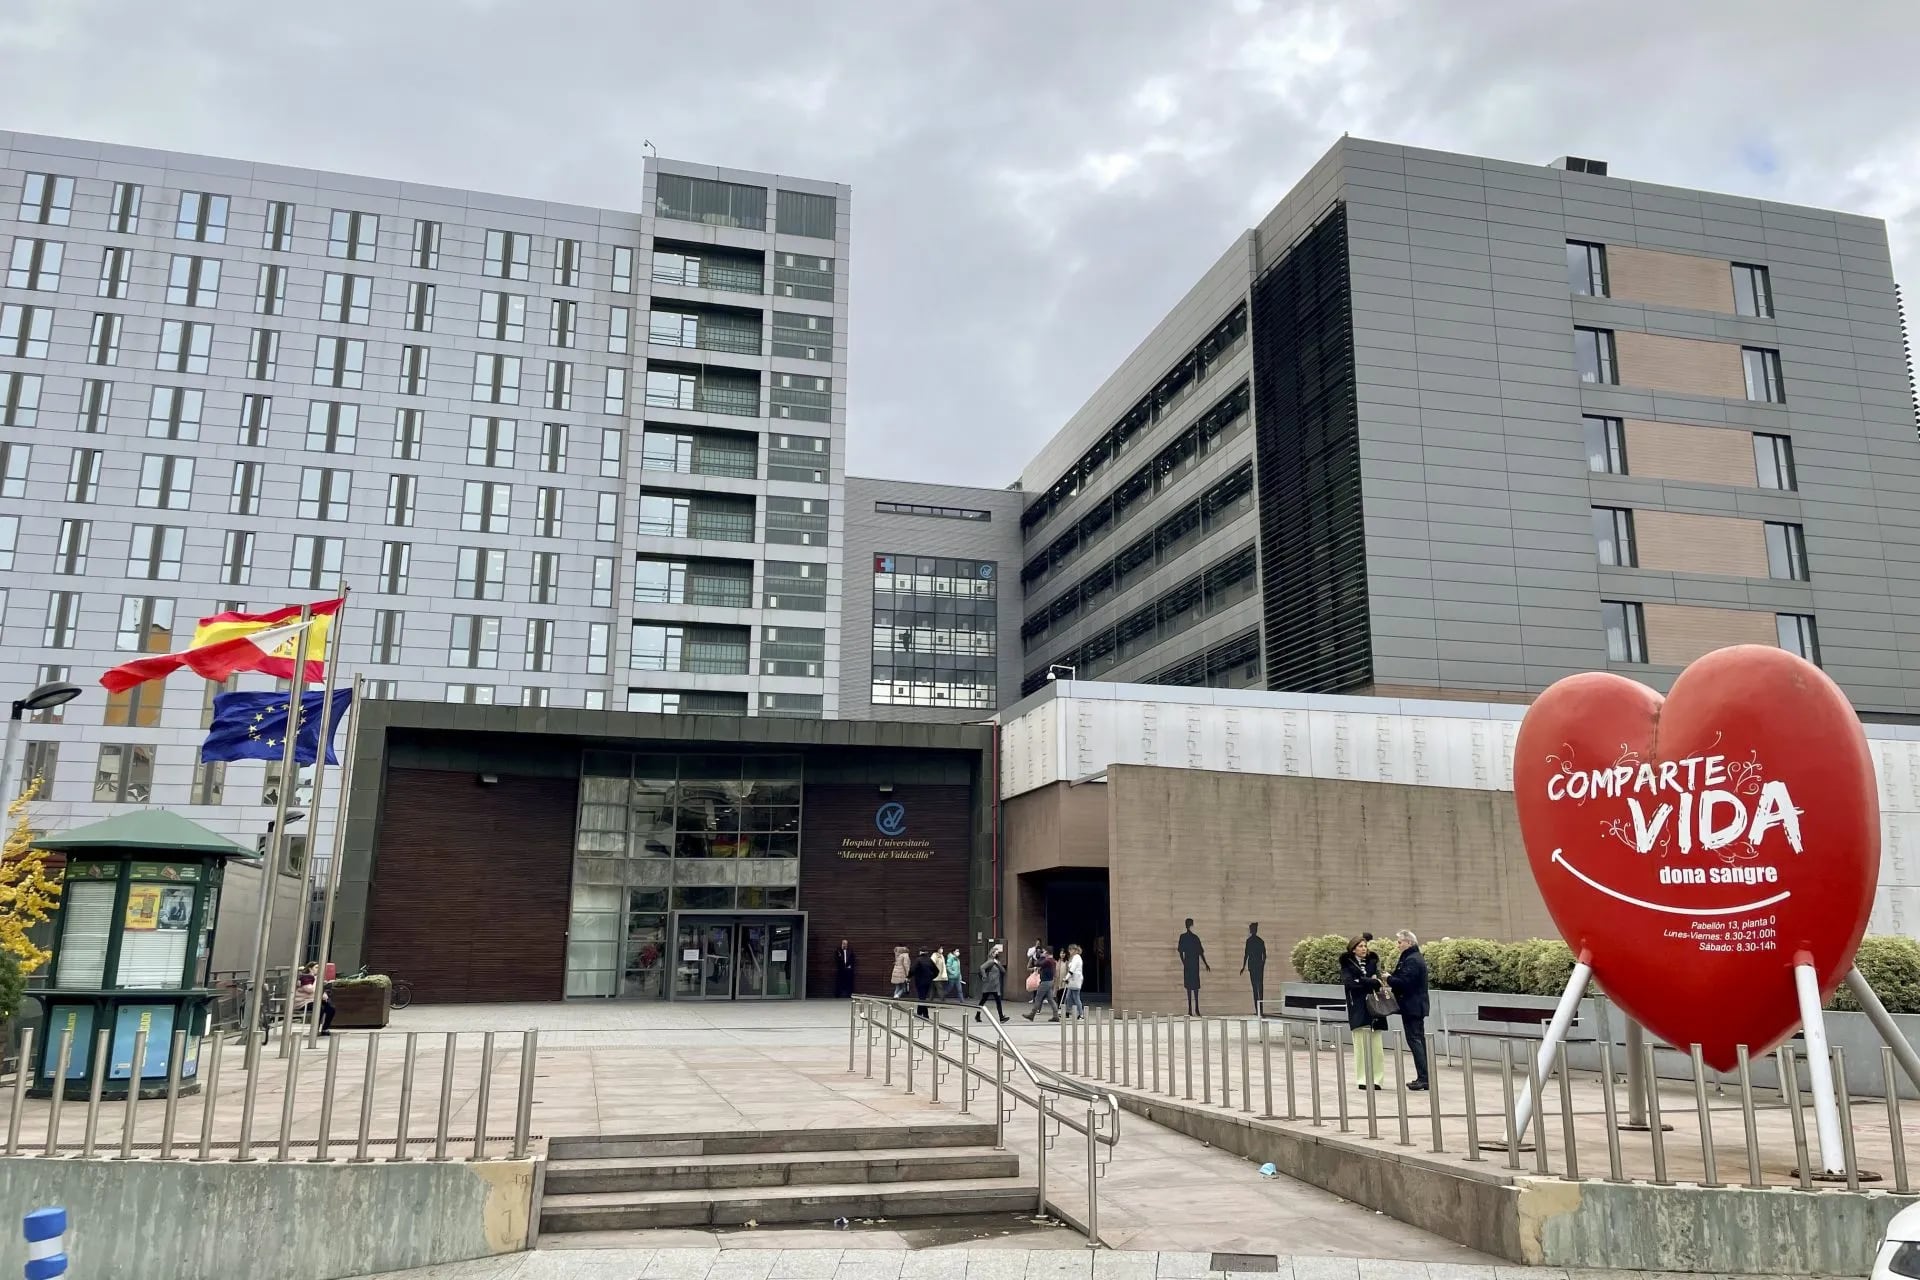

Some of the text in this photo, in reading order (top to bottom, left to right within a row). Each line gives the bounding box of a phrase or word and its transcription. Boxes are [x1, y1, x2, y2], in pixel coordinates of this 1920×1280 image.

[1547, 755, 1727, 800] COMPARTE
[1627, 781, 1804, 854] VIDA
[842, 838, 930, 848] Hospital Universitario
[878, 850, 889, 859] de
[1659, 866, 1778, 885] dona sangre
[1691, 915, 1776, 930] Pabellón 13, planta 0
[1663, 928, 1776, 941] Lunes-Viernes: 8.30-21.00h
[1699, 940, 1776, 952] Sábado: 8.30-14h
